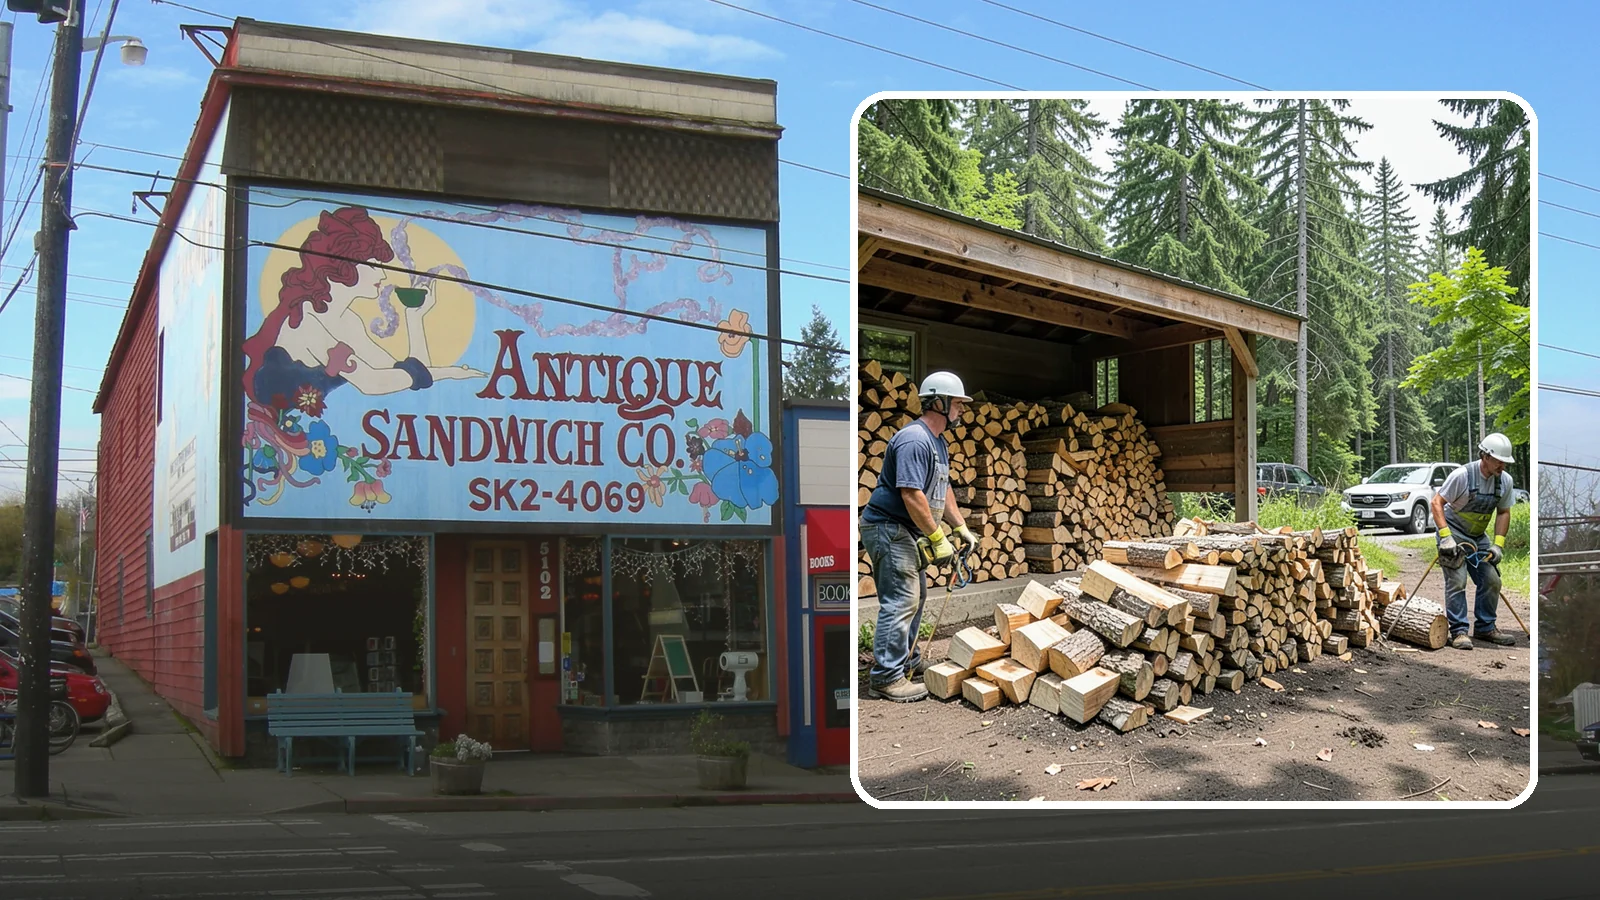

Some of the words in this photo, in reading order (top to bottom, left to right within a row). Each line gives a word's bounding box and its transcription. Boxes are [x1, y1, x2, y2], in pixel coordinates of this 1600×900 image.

[476, 329, 724, 420] ANTIQUE
[361, 408, 604, 467] SANDWICH
[617, 421, 685, 469] CO.
[468, 477, 646, 513] SK2-4069
[540, 542, 552, 599] 5102
[809, 555, 835, 569] BOOKS
